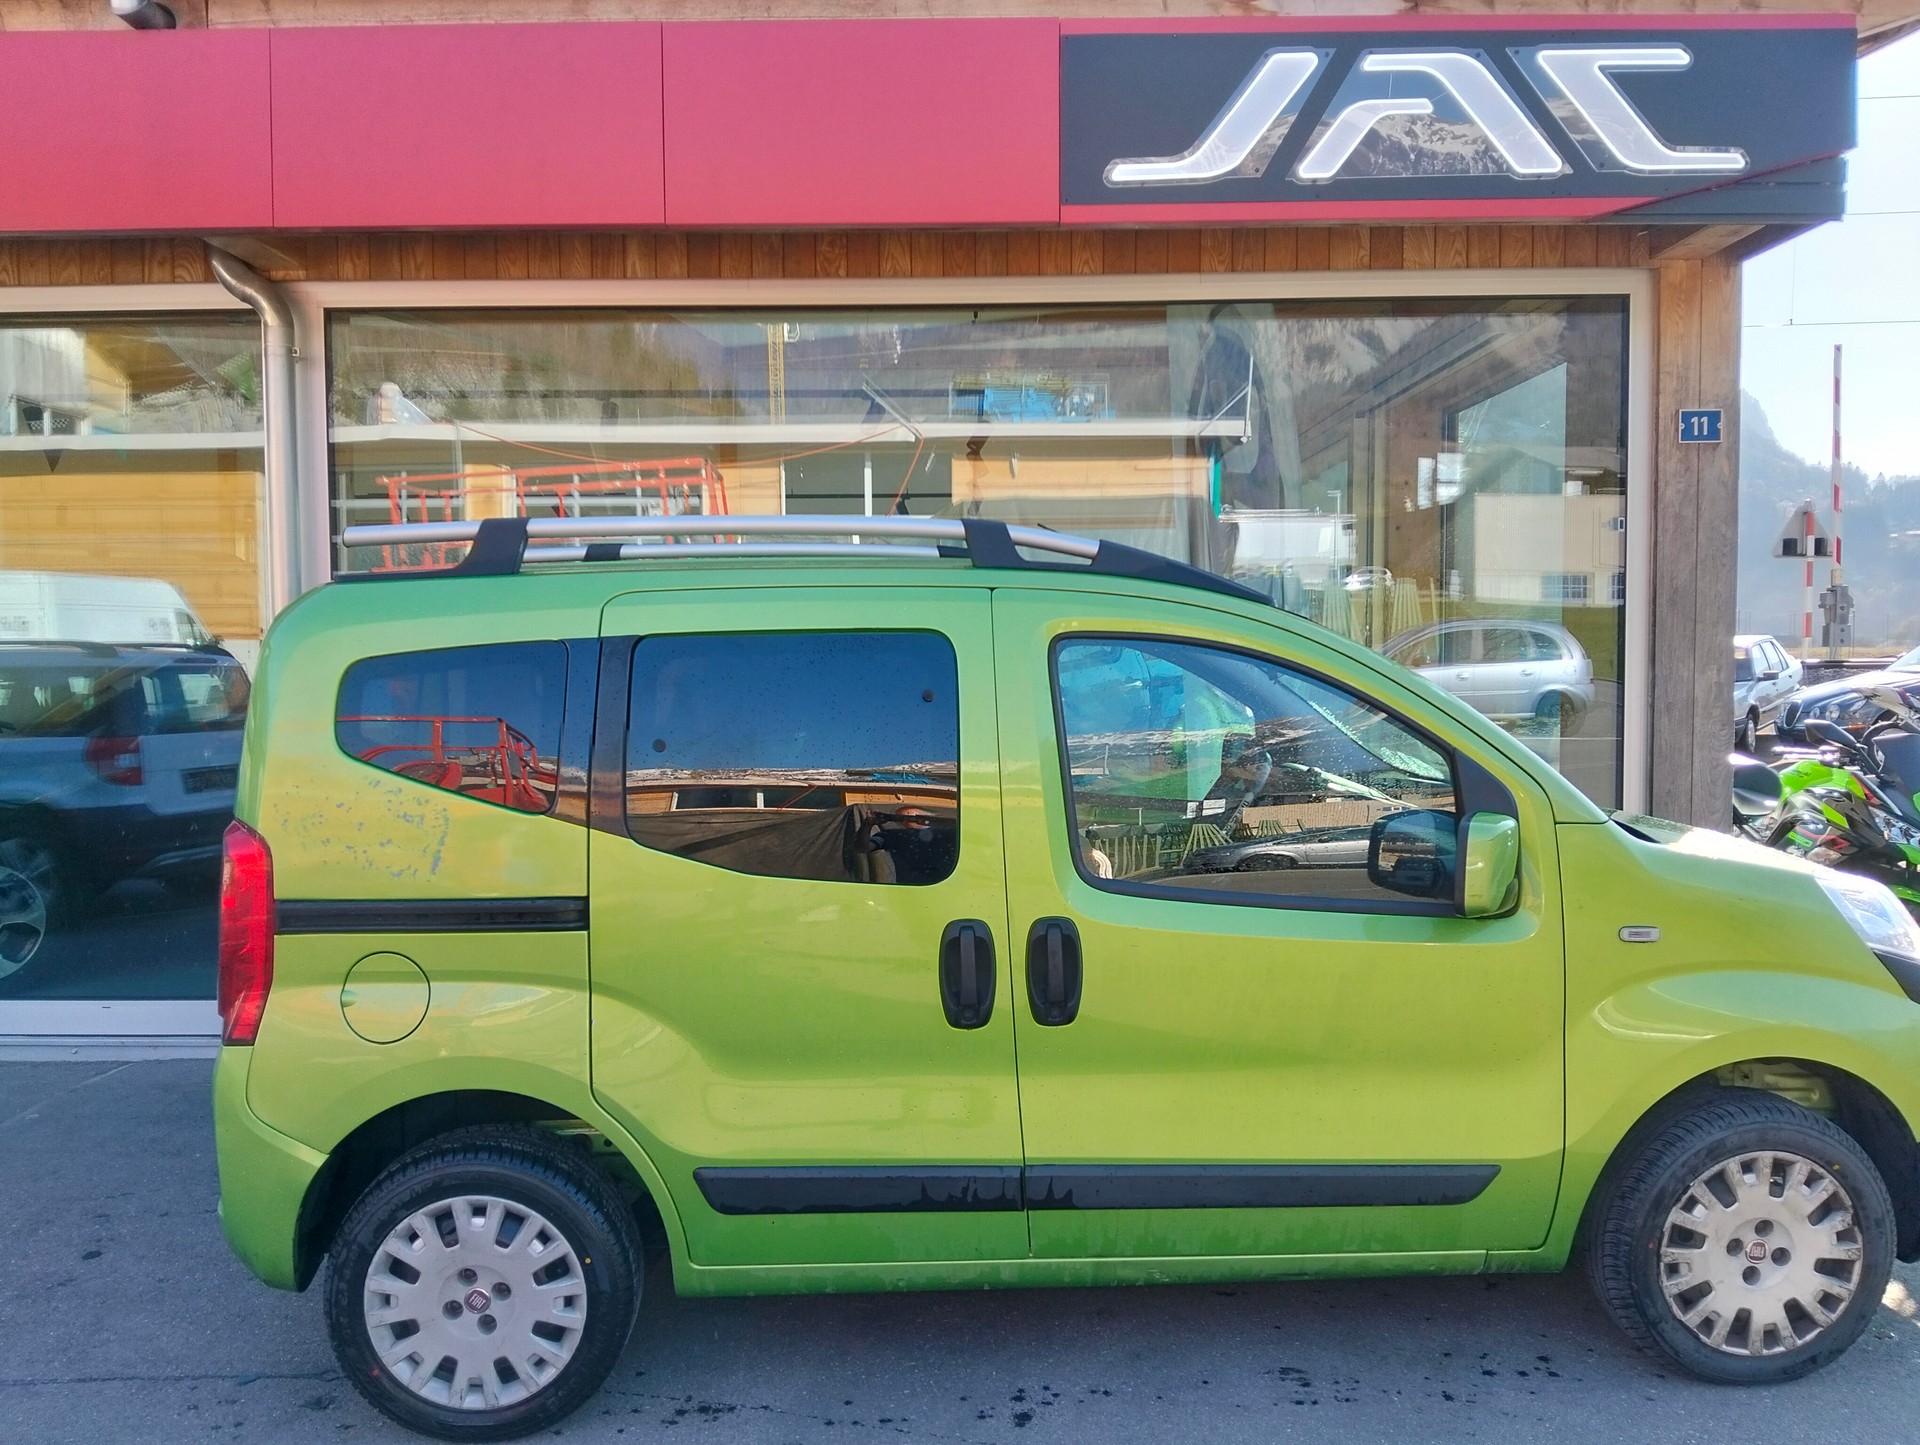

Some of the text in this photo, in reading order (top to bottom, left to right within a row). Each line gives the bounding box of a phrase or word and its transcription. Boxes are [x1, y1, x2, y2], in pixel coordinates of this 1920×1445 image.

[1108, 49, 1748, 181] JAC
[1690, 416, 1708, 436] 11
[469, 1293, 486, 1309] FIAT
